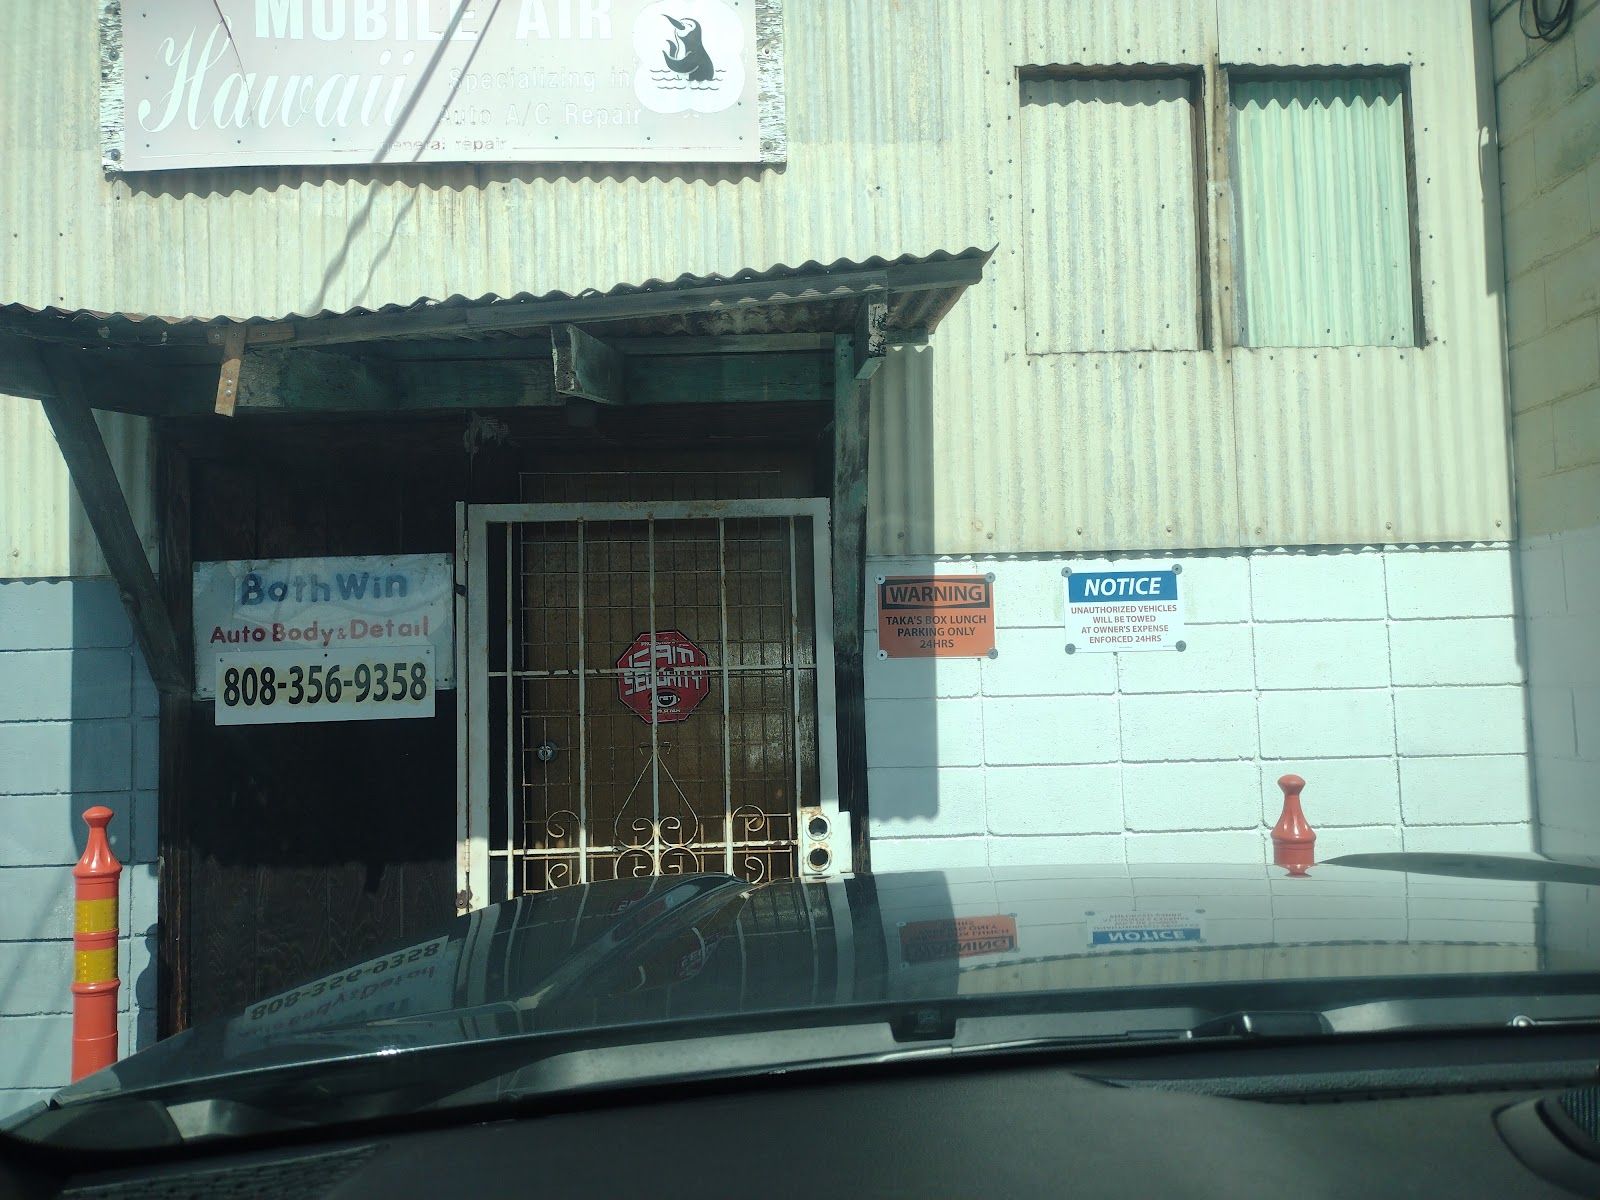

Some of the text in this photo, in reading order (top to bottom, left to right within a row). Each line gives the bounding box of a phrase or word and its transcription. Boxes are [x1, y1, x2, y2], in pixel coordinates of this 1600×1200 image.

[255, 0, 613, 41] MOBILE AIR
[137, 15, 416, 132] Hawaii
[449, 66, 596, 92] Specializing
[442, 101, 643, 128] Auto A/C Repair
[455, 136, 507, 153] repair
[240, 571, 409, 606] Both Win
[889, 585, 982, 603] WARNING
[1084, 577, 1162, 597] NOTICE
[1071, 604, 1177, 614] UNAUTHORIZED VEHICLES
[885, 614, 987, 626] TAKA'S BOX LUNCH
[1092, 615, 1157, 624] WILL BE TOWED
[210, 624, 266, 644] Auto
[271, 620, 334, 647] Body
[350, 615, 429, 640] Detail
[897, 626, 976, 637] PARKING ONLY
[1081, 624, 1169, 634] AT OWNER'S EXPENSE
[919, 639, 954, 649] 24HRS
[1089, 634, 1162, 644] ENFORCED 24HRS
[223, 661, 427, 707] 808-356-9358
